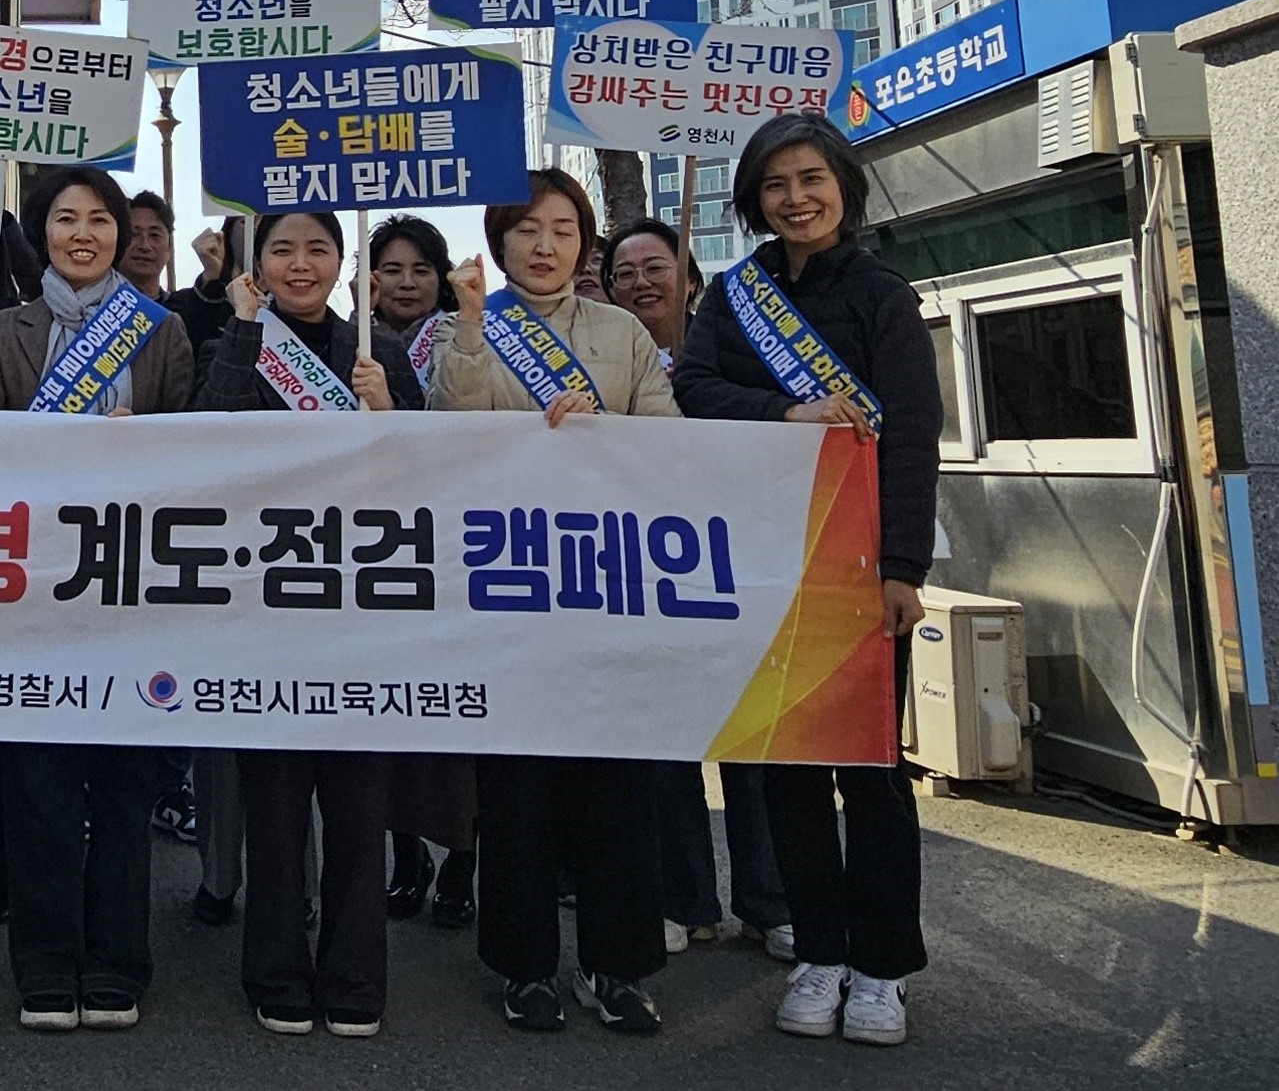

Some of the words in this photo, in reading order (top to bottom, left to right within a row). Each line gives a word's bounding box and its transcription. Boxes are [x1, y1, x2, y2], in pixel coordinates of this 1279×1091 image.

[176, 24, 333, 59] 보호합시다
[572, 31, 694, 70] 상처받은
[706, 37, 833, 77] 친구마음
[875, 23, 1010, 110] 포은초등학교
[246, 61, 480, 114] 청소년들에게
[568, 72, 690, 110] 감싸주는
[703, 78, 829, 120] 멋진우정
[687, 126, 736, 147] 영천시
[263, 161, 340, 205] 팔지
[352, 154, 472, 201] 맙시다
[740, 261, 804, 340] 청소년을
[54, 289, 139, 383] 유해환경으로
[92, 310, 154, 379] 청소년을
[501, 304, 571, 373] 청소년을
[52, 502, 437, 612] 계도·점검
[462, 506, 741, 621] 캠페인
[191, 674, 490, 720] 영천시교육지원청
